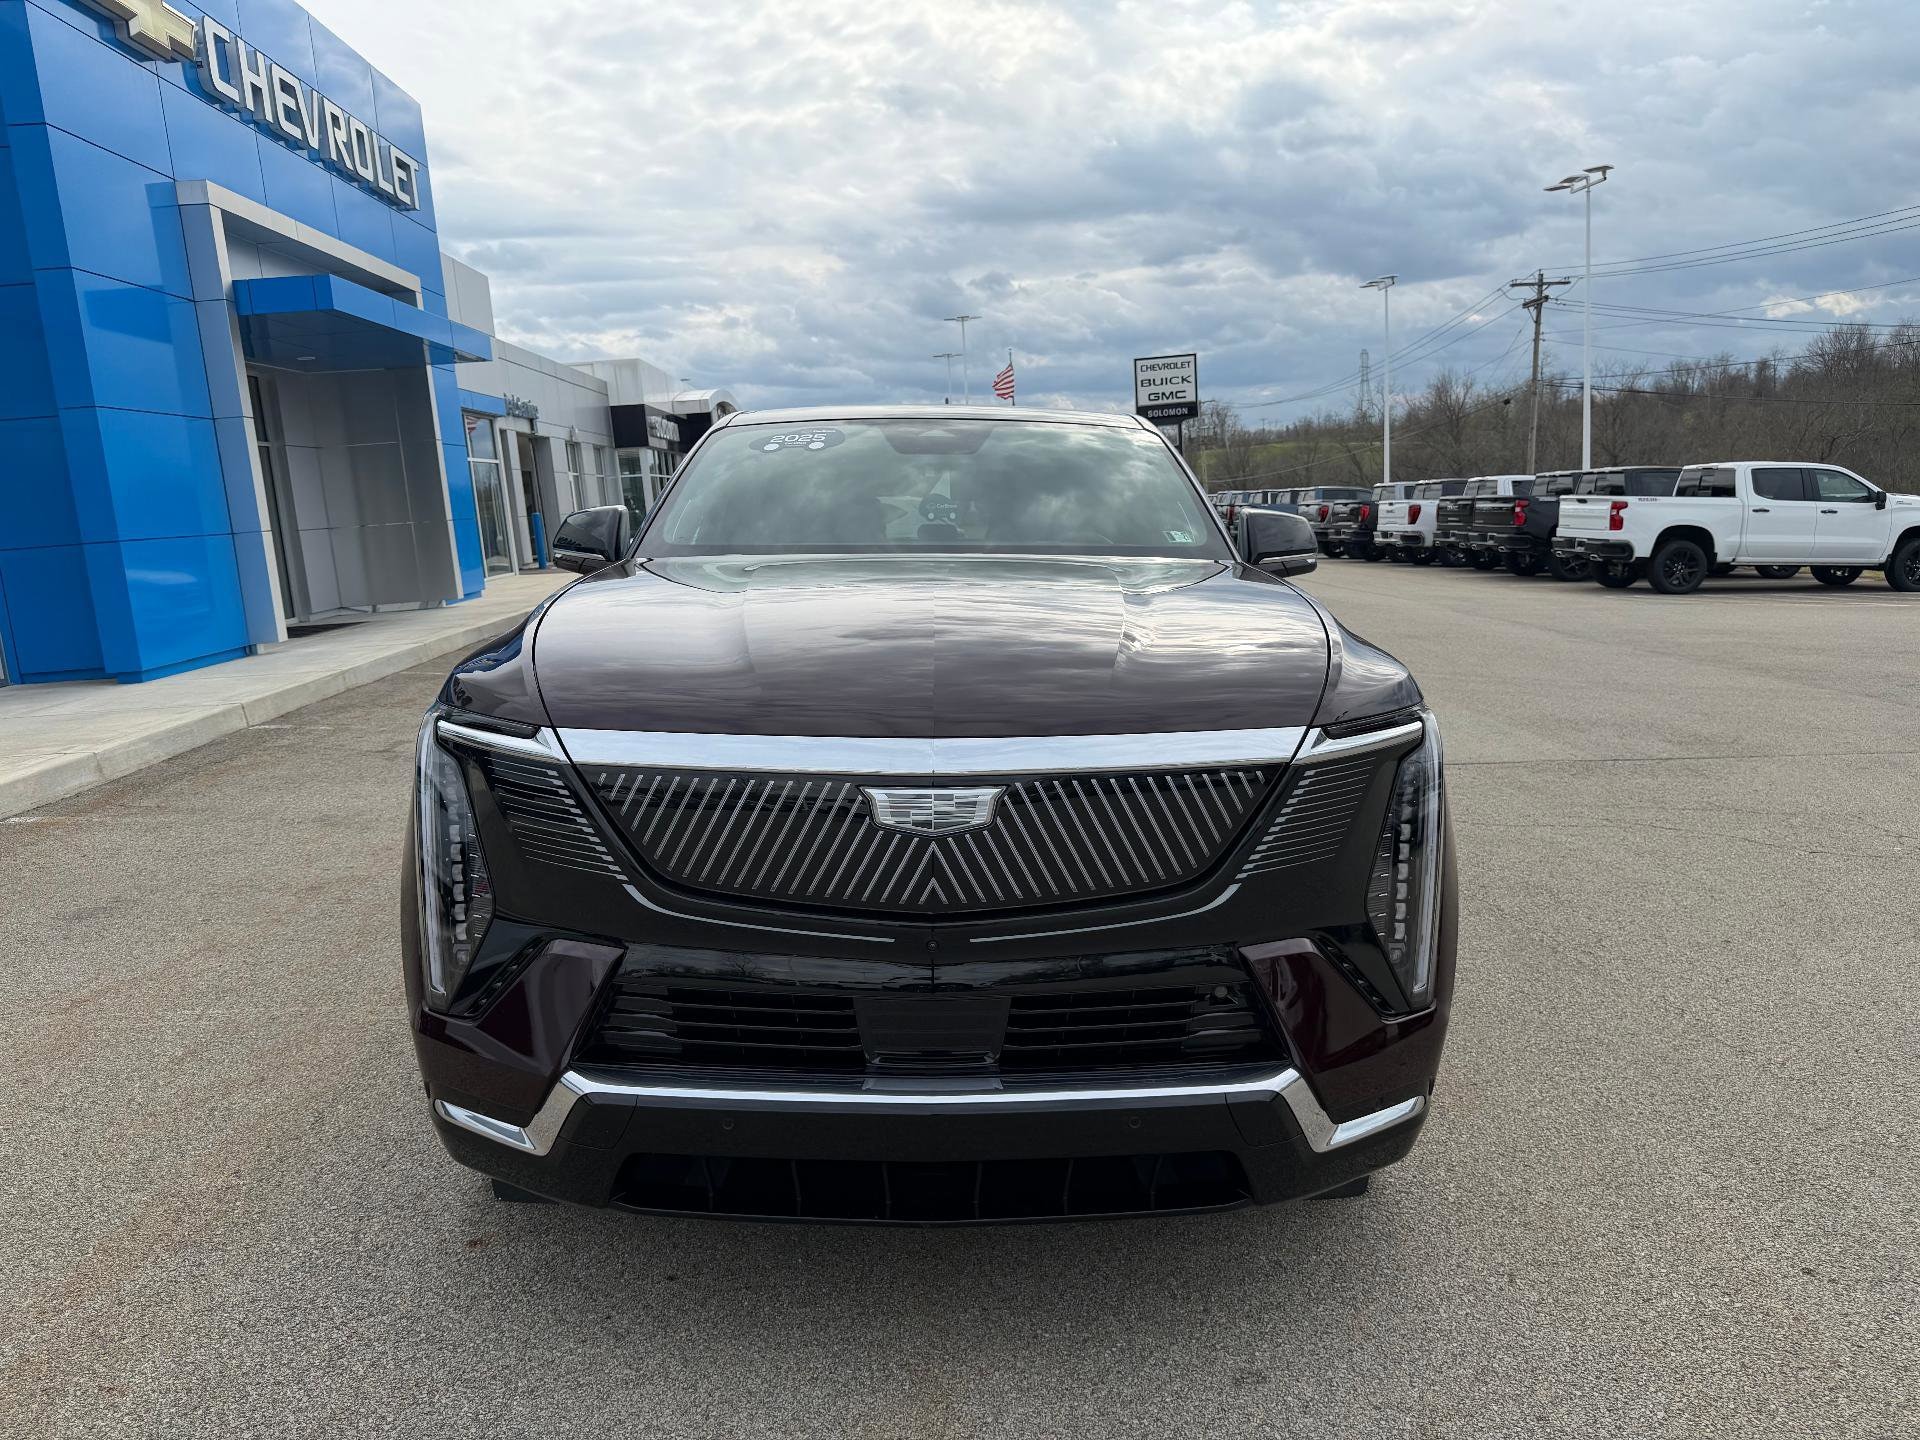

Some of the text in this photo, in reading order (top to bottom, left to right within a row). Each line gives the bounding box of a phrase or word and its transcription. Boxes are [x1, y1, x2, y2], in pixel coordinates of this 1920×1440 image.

[202, 15, 420, 211] CHEVROLET
[1140, 360, 1191, 372] CHEVROLET
[1140, 375, 1192, 387] BUICK
[1148, 390, 1187, 401] GMC
[1147, 407, 1188, 417] SOLOMON
[770, 433, 827, 443] 2025
